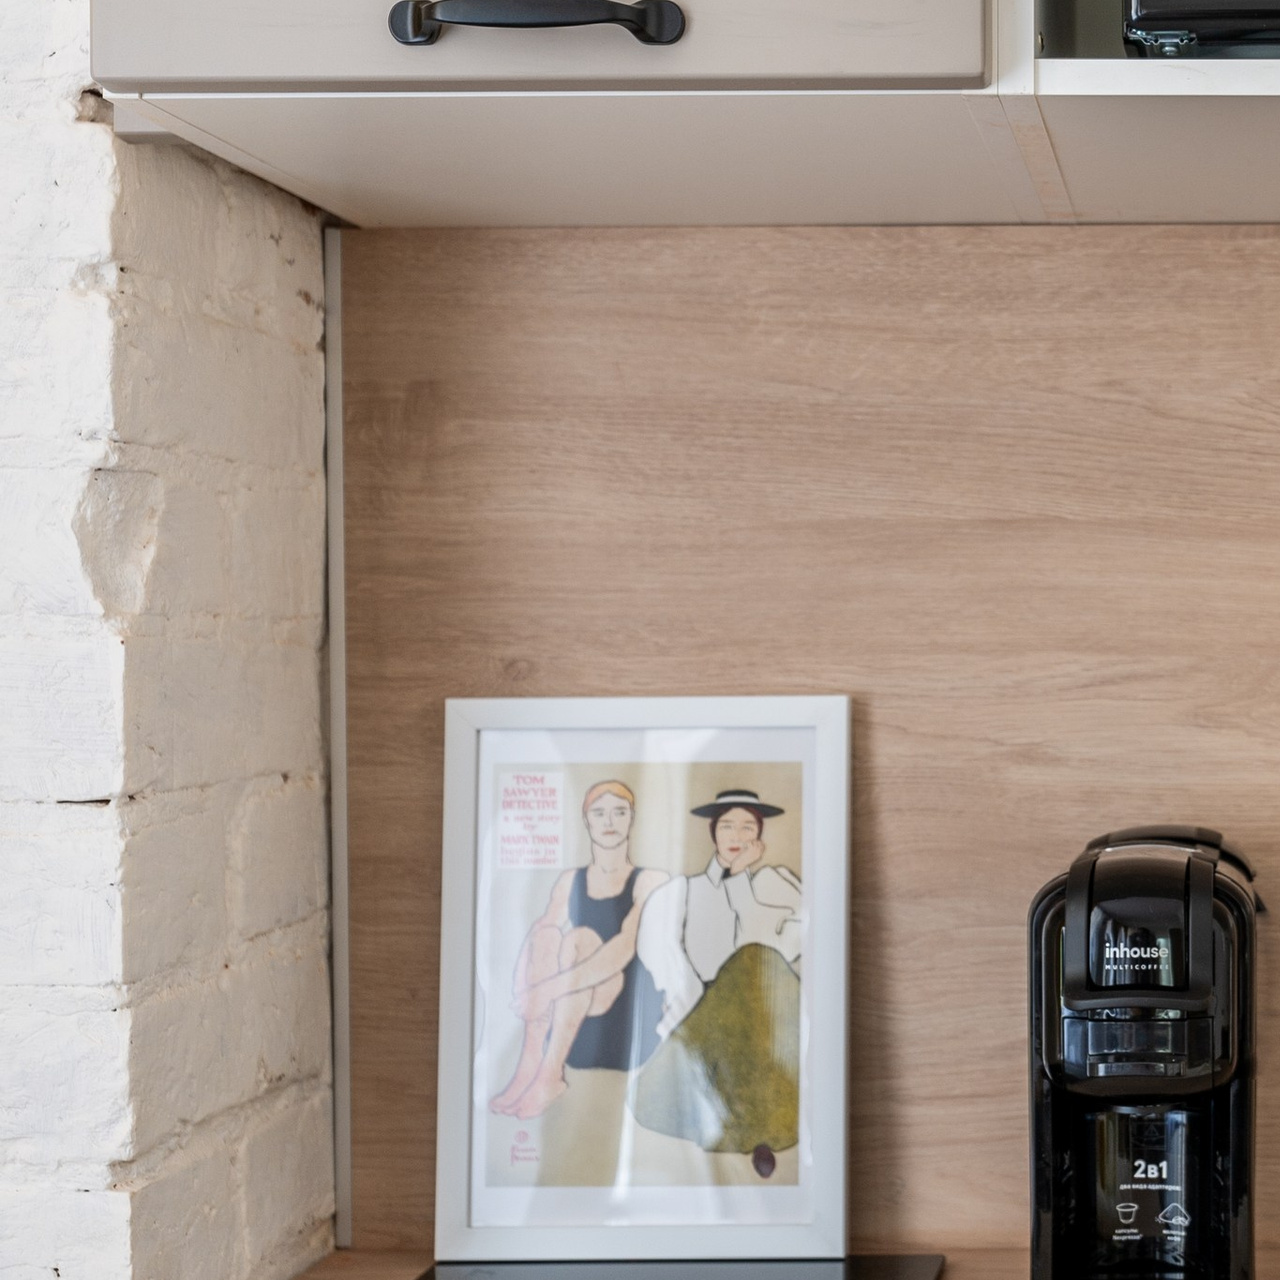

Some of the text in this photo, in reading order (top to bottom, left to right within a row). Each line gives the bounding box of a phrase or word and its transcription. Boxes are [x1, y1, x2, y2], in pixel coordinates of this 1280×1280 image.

[513, 775, 545, 785] TOM
[503, 787, 557, 797] SAWYER
[502, 800, 557, 810] DETECTIVE
[501, 835, 559, 844] MARK TWAIN
[1105, 942, 1169, 958] inhouse
